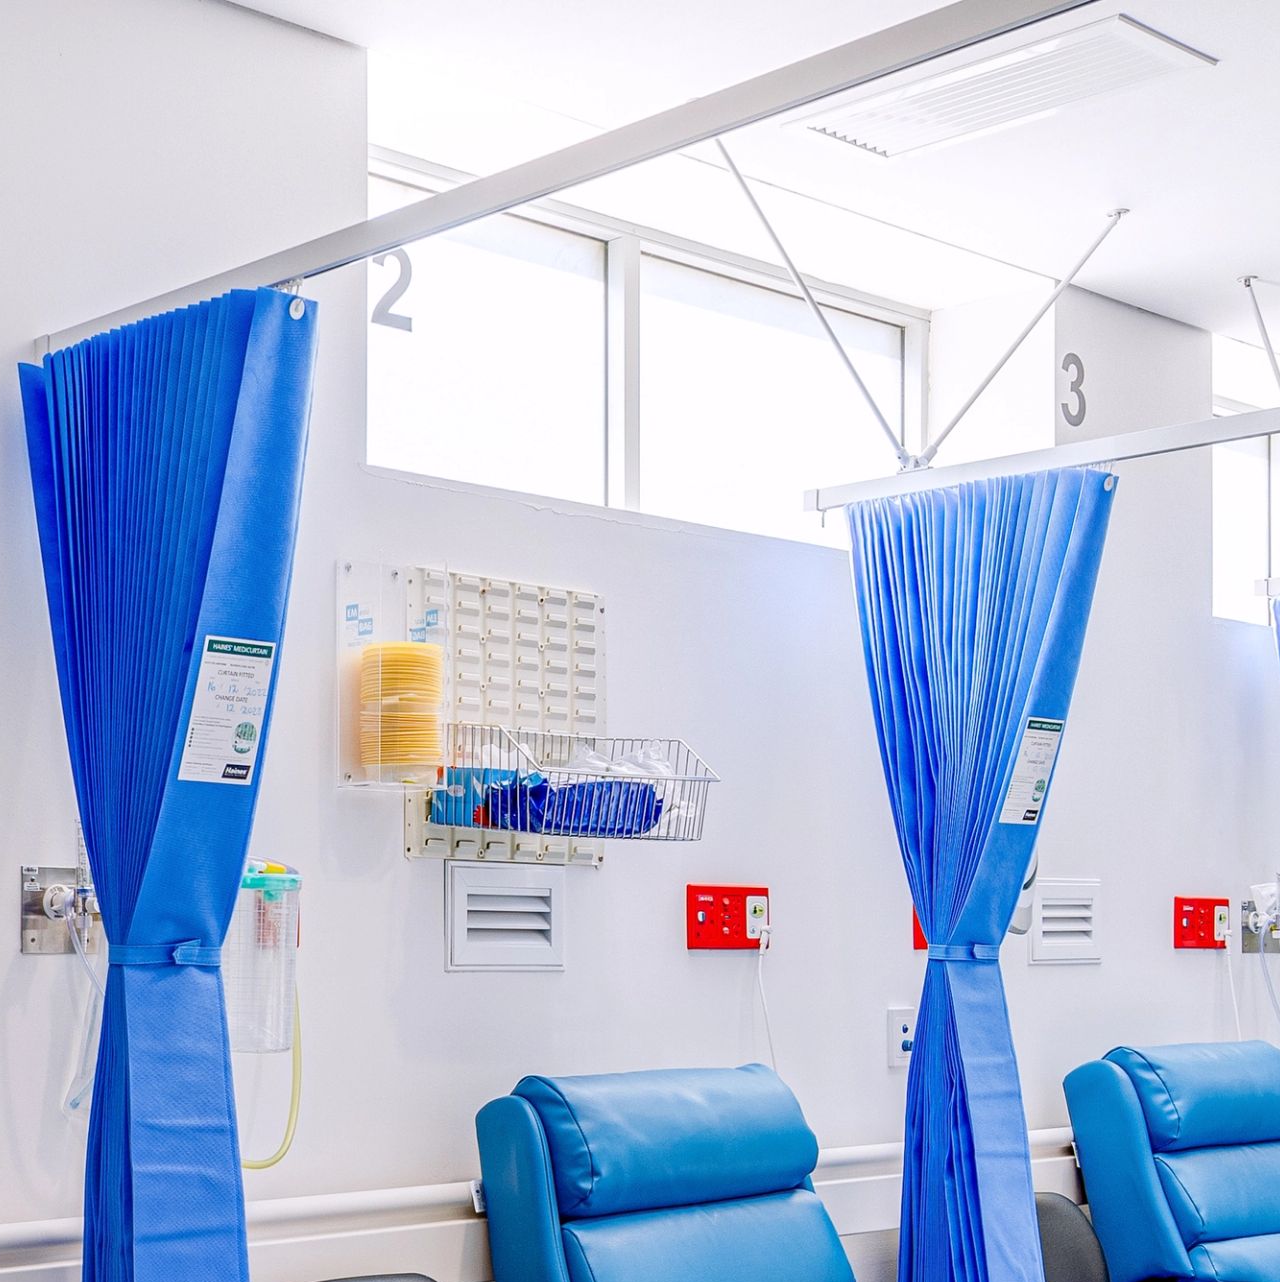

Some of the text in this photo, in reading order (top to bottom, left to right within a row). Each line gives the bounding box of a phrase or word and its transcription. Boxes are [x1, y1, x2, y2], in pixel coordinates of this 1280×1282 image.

[371, 248, 412, 332] 2
[1061, 353, 1086, 427] 3
[233, 645, 268, 655] MEDICURTAIN
[215, 694, 235, 702] CHANGE
